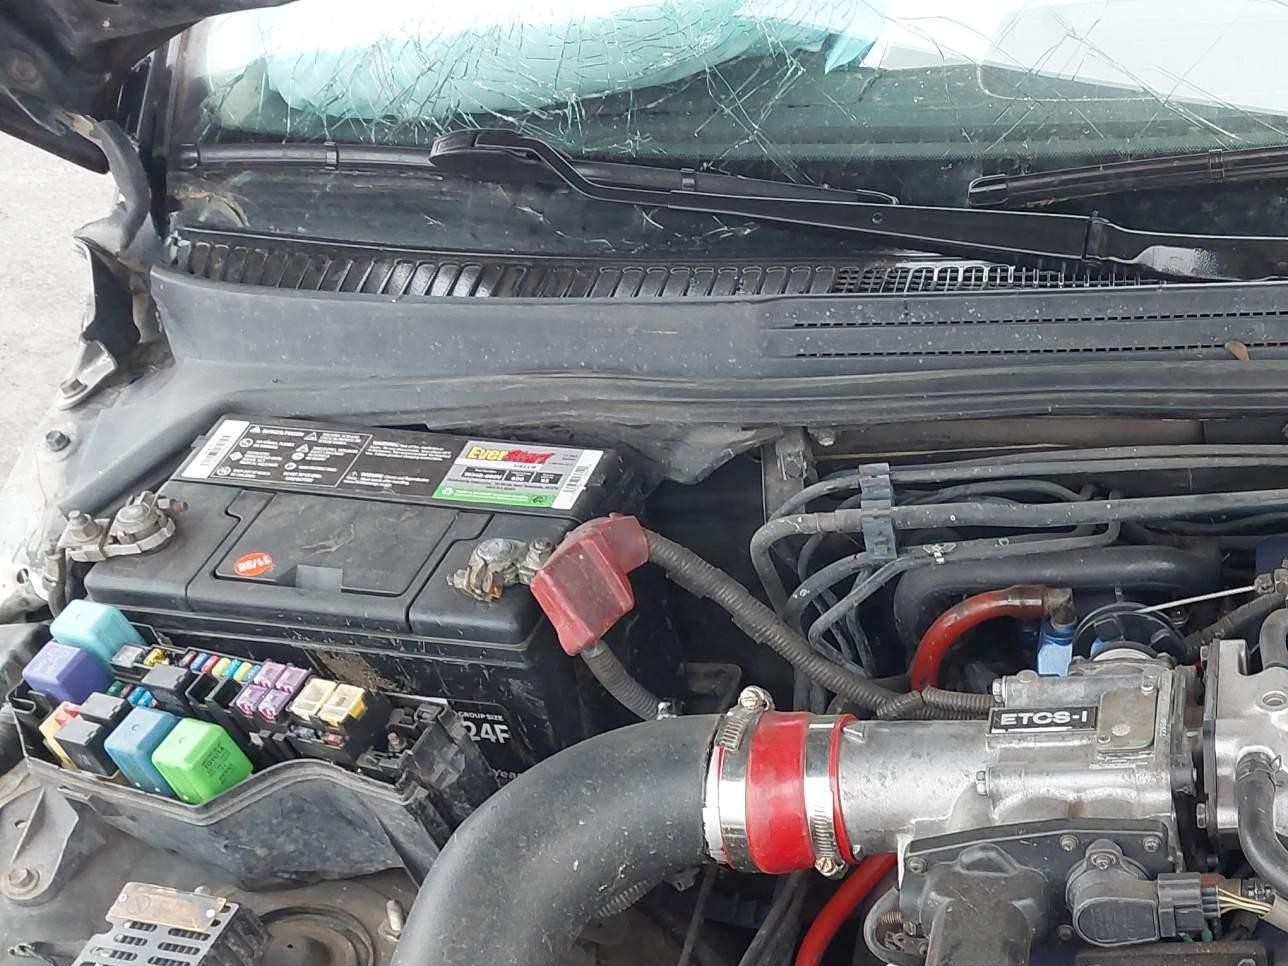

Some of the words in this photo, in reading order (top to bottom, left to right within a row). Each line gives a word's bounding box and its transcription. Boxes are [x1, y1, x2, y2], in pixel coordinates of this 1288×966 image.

[467, 446, 555, 465] EverStart
[458, 710, 486, 720] GROUP
[486, 713, 504, 721] SIZE
[1000, 710, 1088, 727] ETCS-I
[463, 720, 510, 744] 24F
